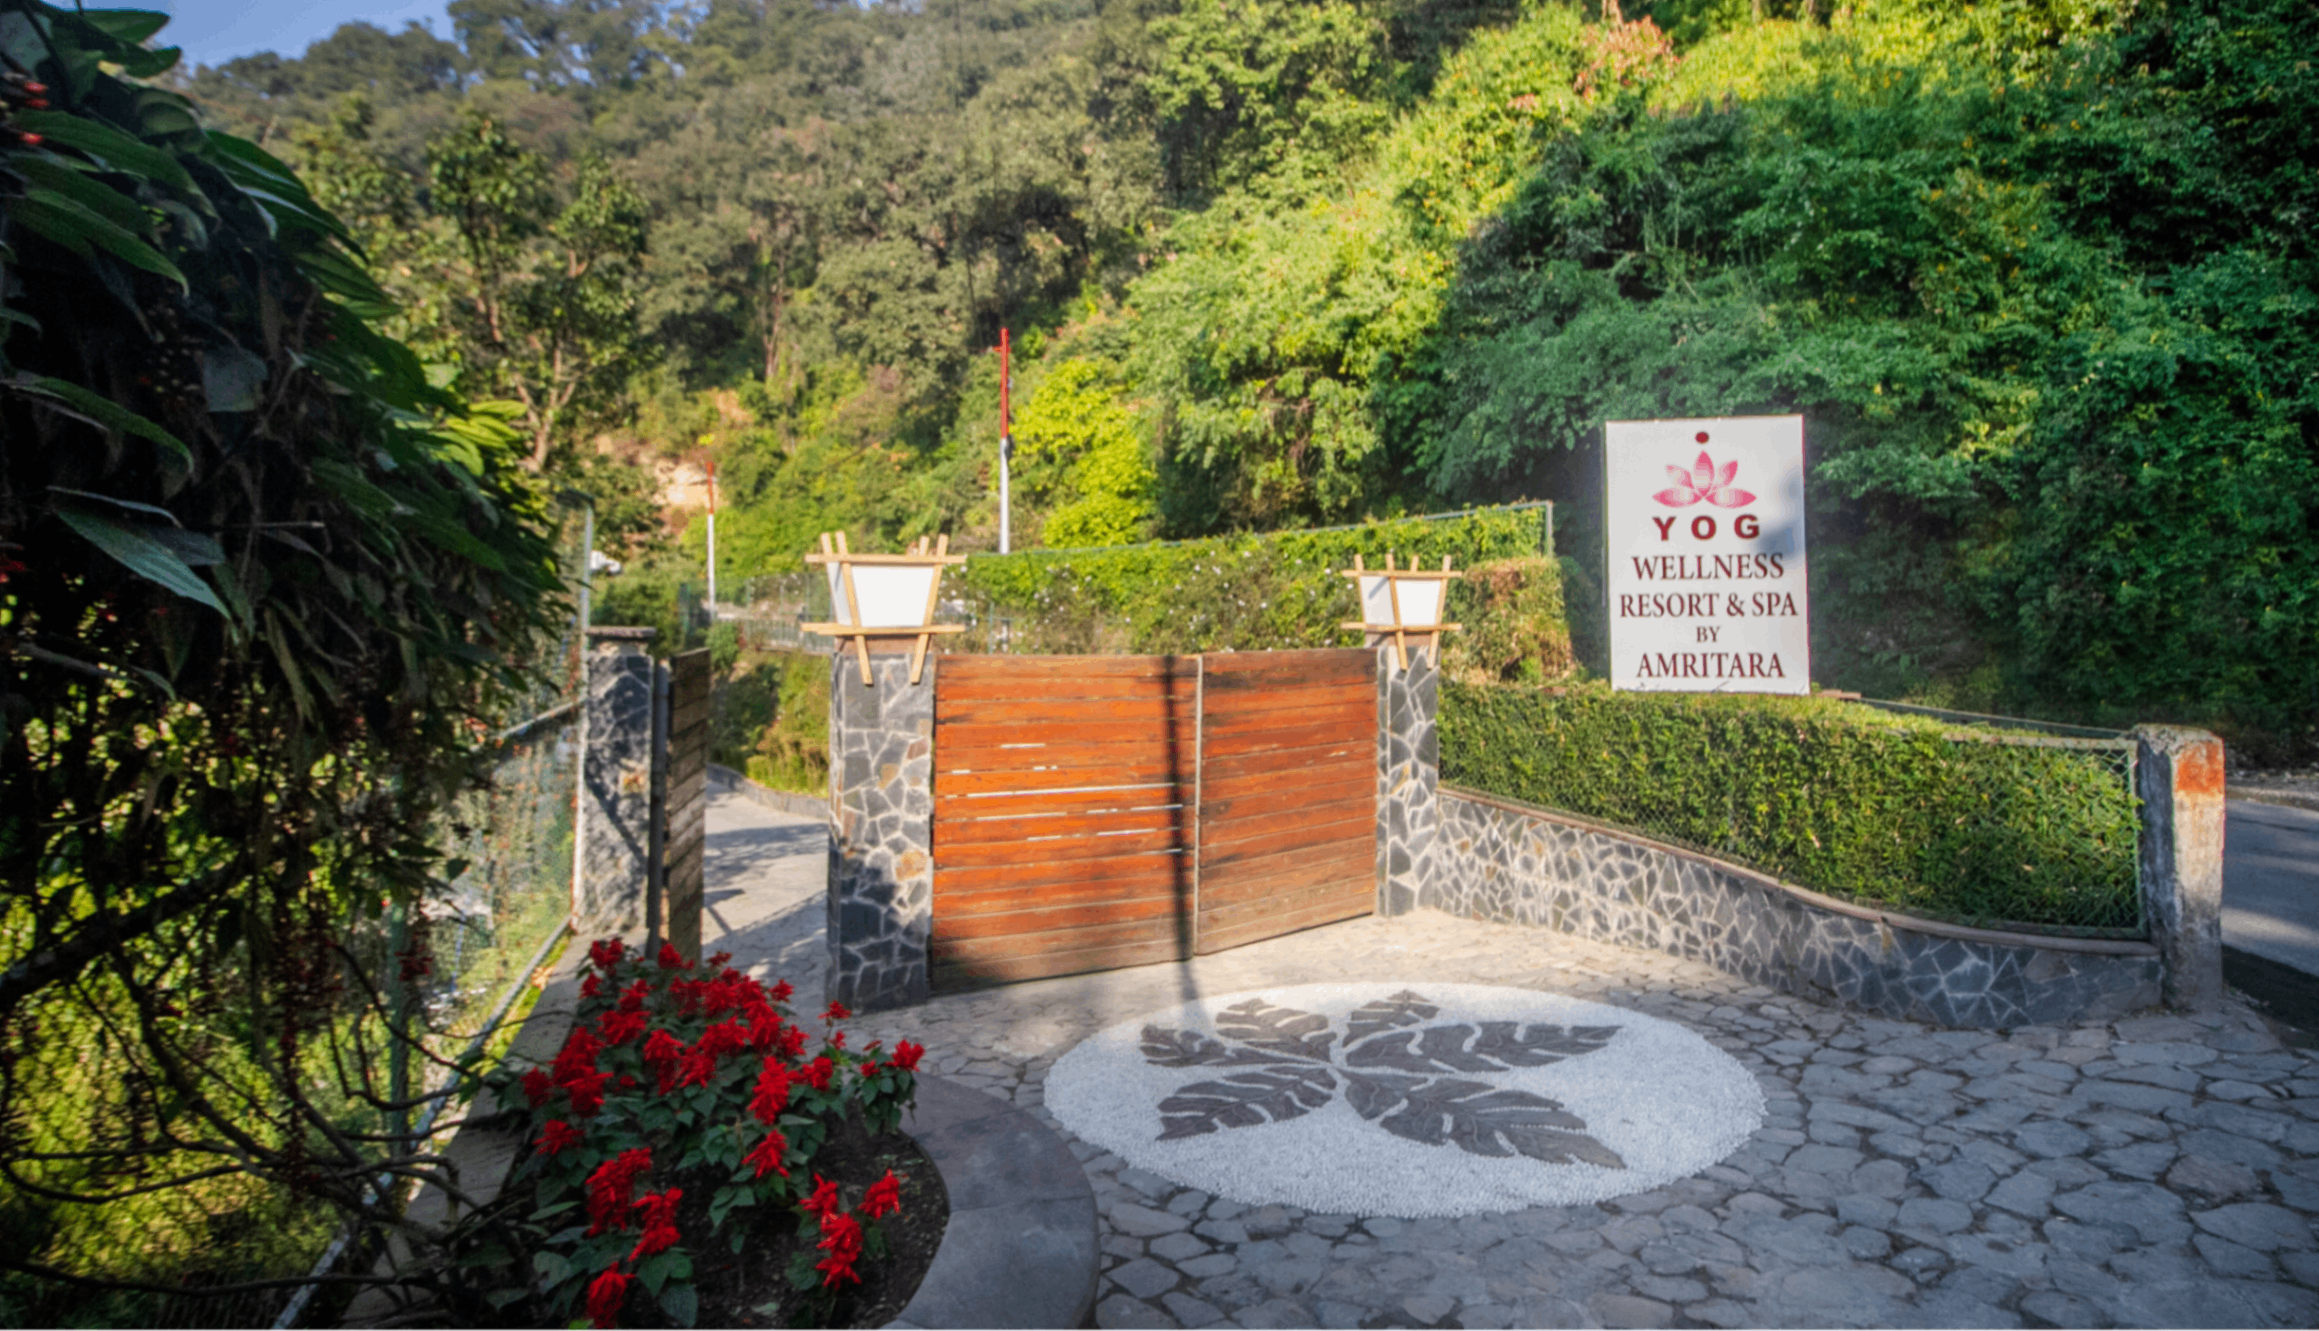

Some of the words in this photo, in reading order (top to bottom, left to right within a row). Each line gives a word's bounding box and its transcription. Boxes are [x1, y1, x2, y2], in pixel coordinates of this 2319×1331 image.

[1652, 514, 1760, 541] YOG
[1632, 552, 1785, 580] WELLNESS
[1619, 592, 1720, 618] RESORT
[1726, 593, 1745, 617] &
[1752, 591, 1798, 617] SPA
[1696, 625, 1720, 643] BY
[1636, 652, 1786, 678] AMRITARA
